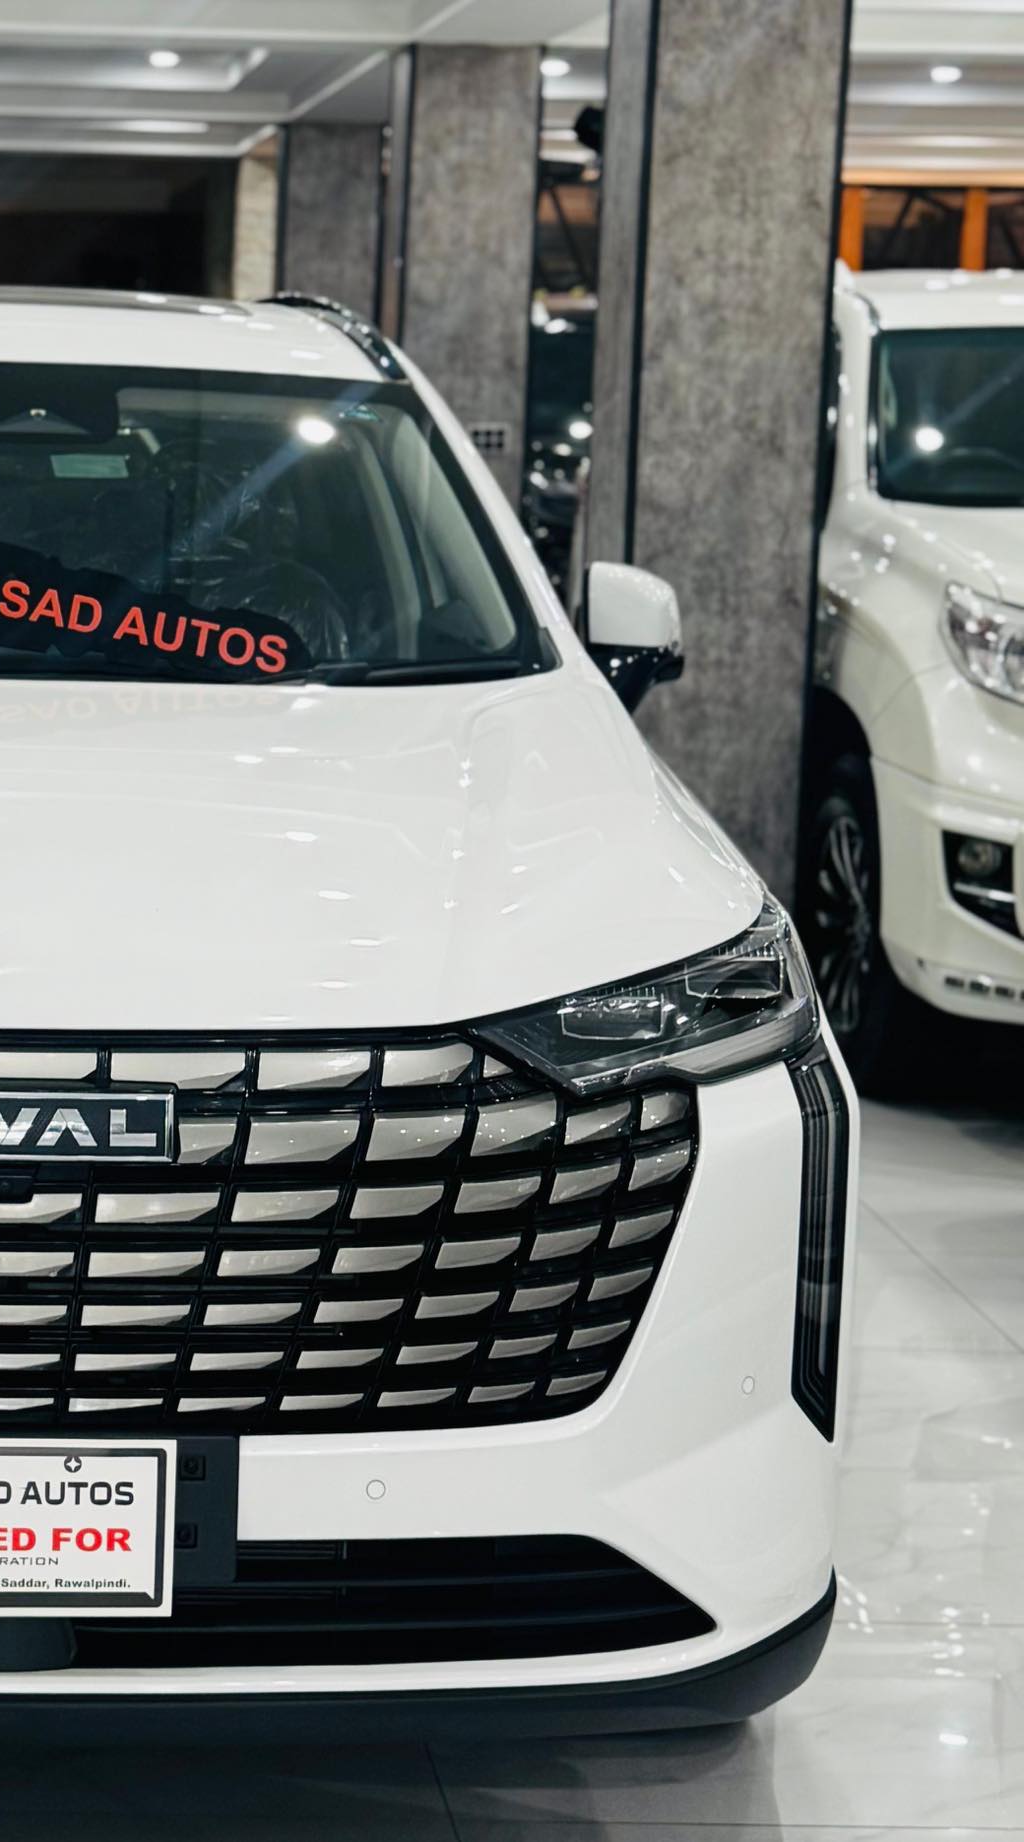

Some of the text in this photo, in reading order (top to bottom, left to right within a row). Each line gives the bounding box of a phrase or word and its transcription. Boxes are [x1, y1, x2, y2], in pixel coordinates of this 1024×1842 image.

[113, 607, 288, 673] AUTOS
[20, 1481, 134, 1506] AUTOS
[51, 1527, 132, 1552] FOR
[1, 1578, 50, 1590] Saddar,
[55, 1578, 131, 1590] Rawalpindi.
